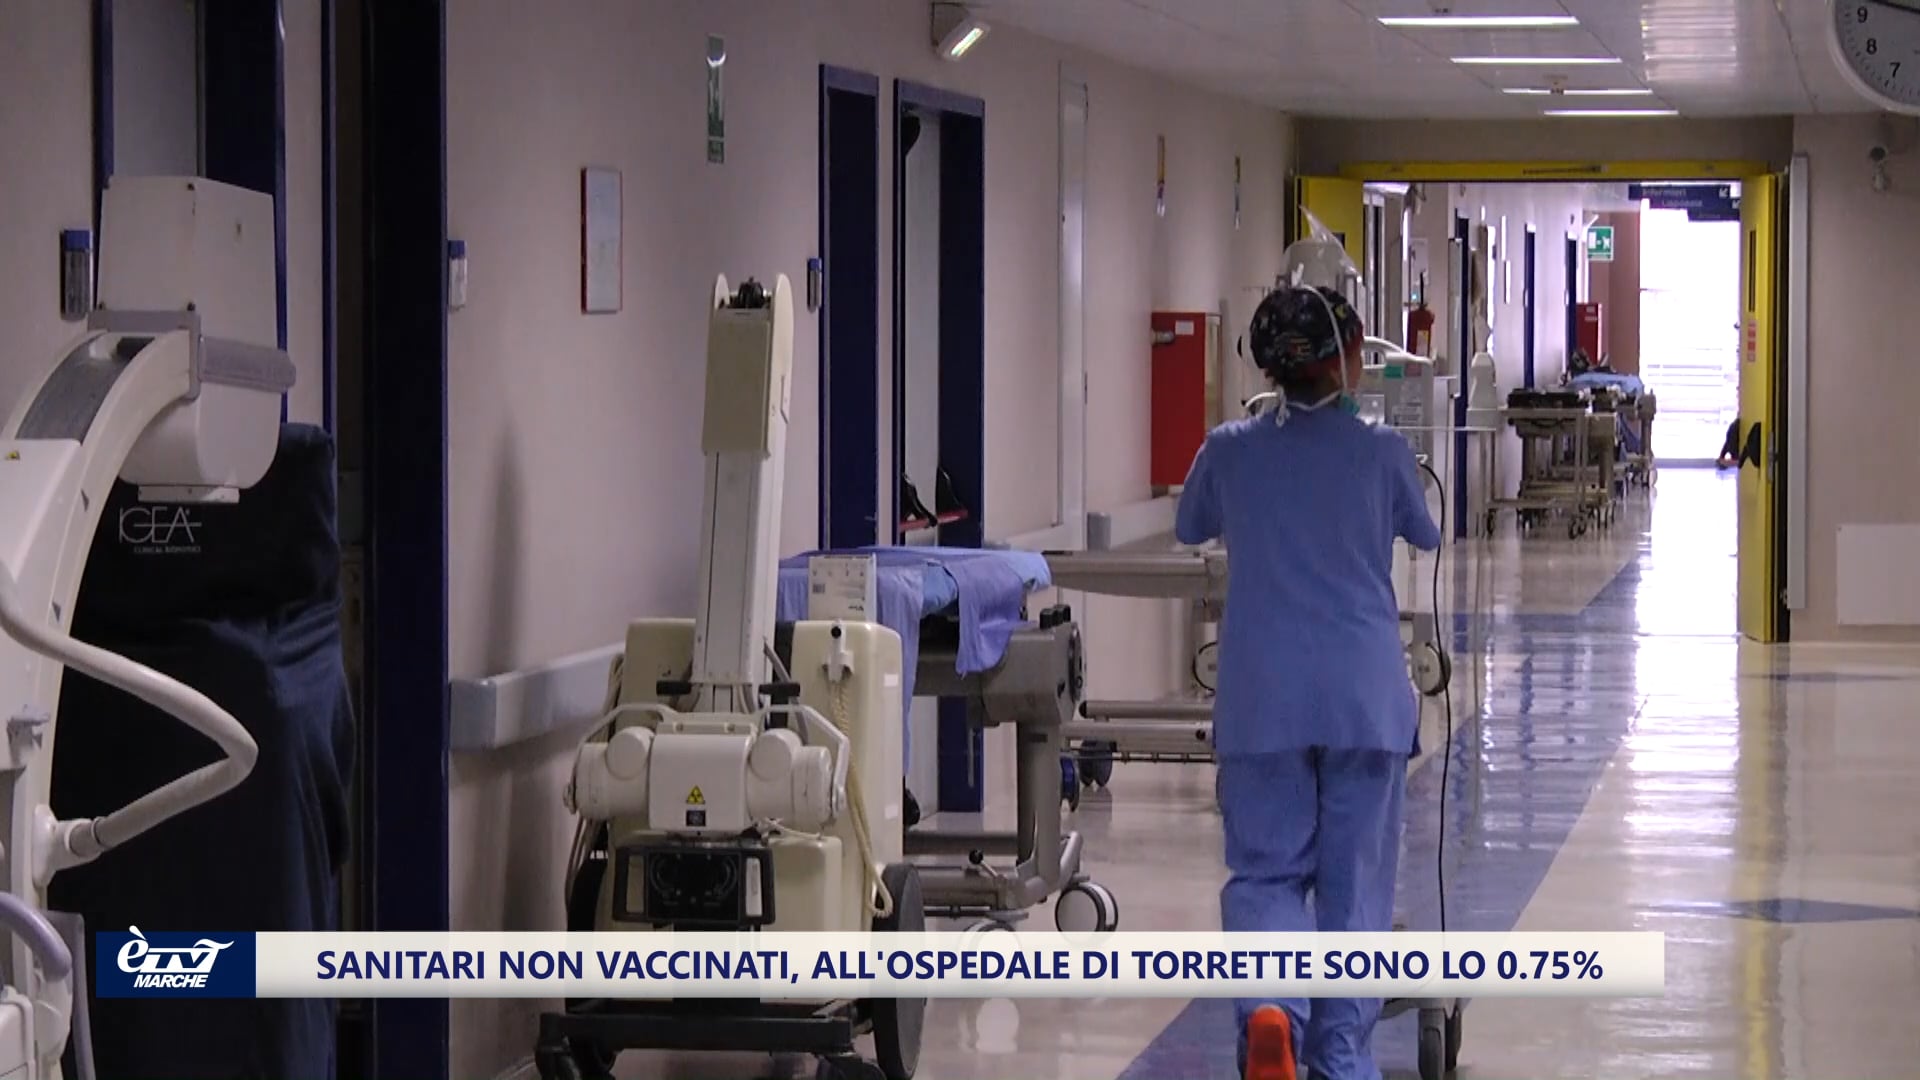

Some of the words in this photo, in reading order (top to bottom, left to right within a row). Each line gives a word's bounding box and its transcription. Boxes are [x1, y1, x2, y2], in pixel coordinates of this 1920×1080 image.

[1857, 6, 1868, 23] 9
[1866, 38, 1877, 55] 8
[1890, 62, 1901, 78] 7
